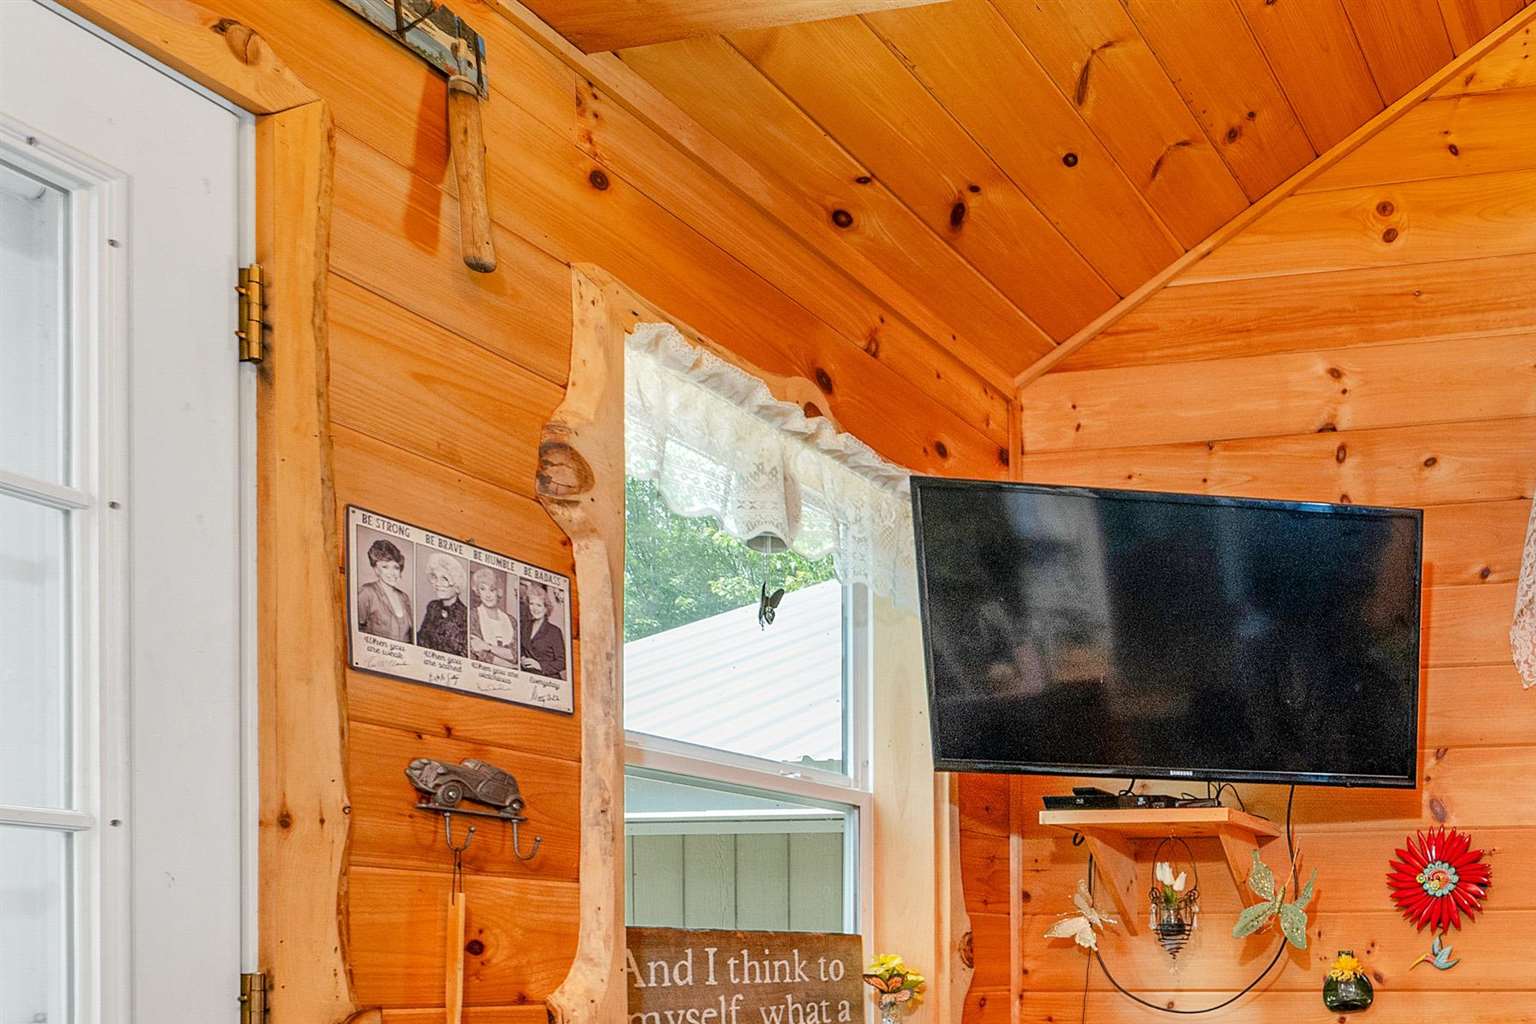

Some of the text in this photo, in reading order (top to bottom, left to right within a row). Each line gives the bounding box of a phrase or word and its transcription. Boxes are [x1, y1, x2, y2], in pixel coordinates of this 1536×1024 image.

[362, 513, 411, 538] BE STRONG
[425, 534, 465, 555] BE BRAVE
[473, 549, 516, 572] BE HUMBLE
[523, 566, 562, 585] BE BADASS
[625, 947, 845, 988] And I think to
[837, 999, 852, 1023] a
